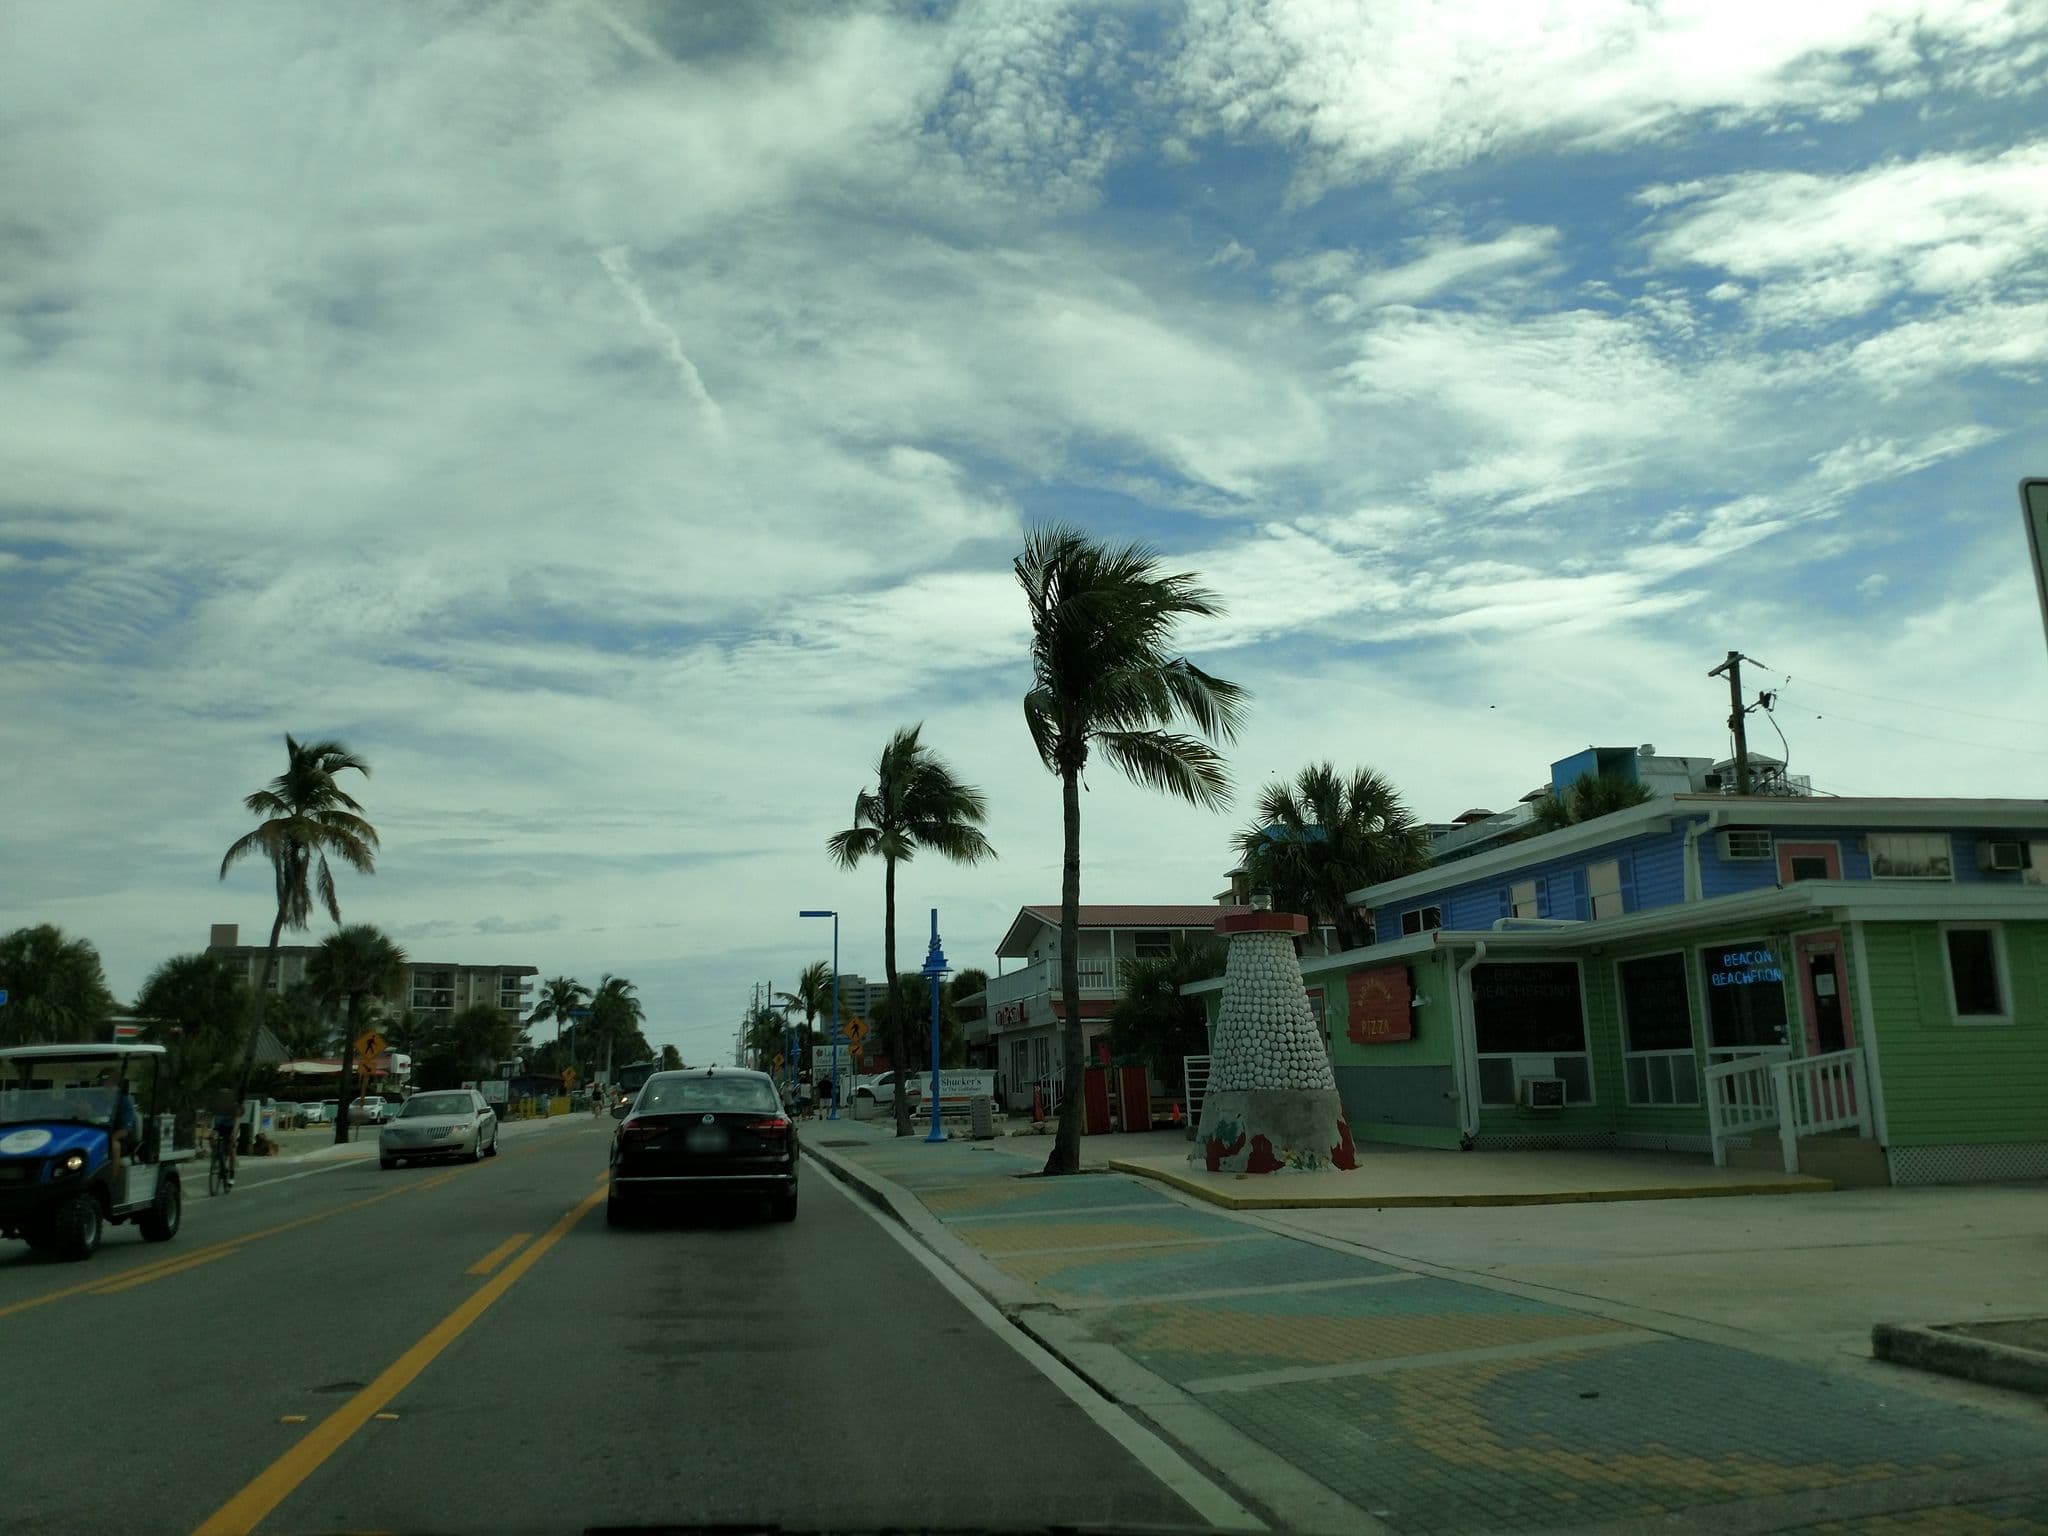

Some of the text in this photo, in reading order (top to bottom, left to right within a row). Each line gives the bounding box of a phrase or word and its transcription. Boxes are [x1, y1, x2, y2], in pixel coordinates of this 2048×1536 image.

[1723, 950, 1773, 967] BEACON
[1711, 968, 1784, 987] BEACHFRON
[1361, 1019, 1391, 1035] PIZZA
[941, 1077, 982, 1087] Shucker's
